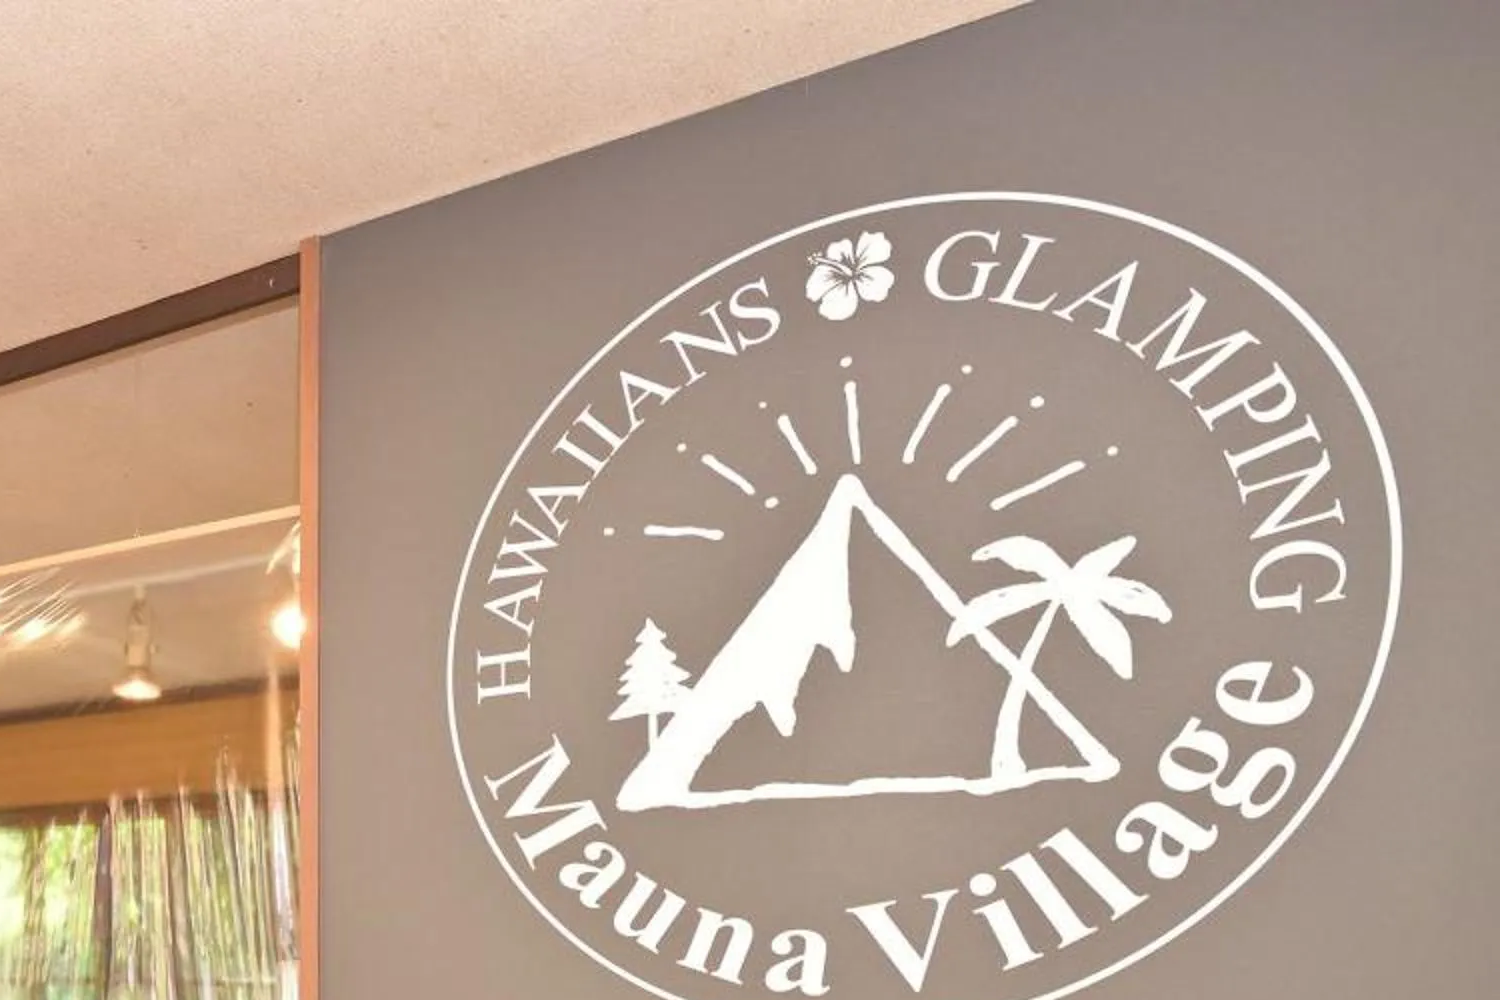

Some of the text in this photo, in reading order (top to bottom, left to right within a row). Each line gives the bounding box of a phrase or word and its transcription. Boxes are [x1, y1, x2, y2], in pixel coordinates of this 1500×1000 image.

[476, 229, 1348, 704] HAWAIIANS GLAMPING
[485, 660, 1314, 998] Mauna Village
